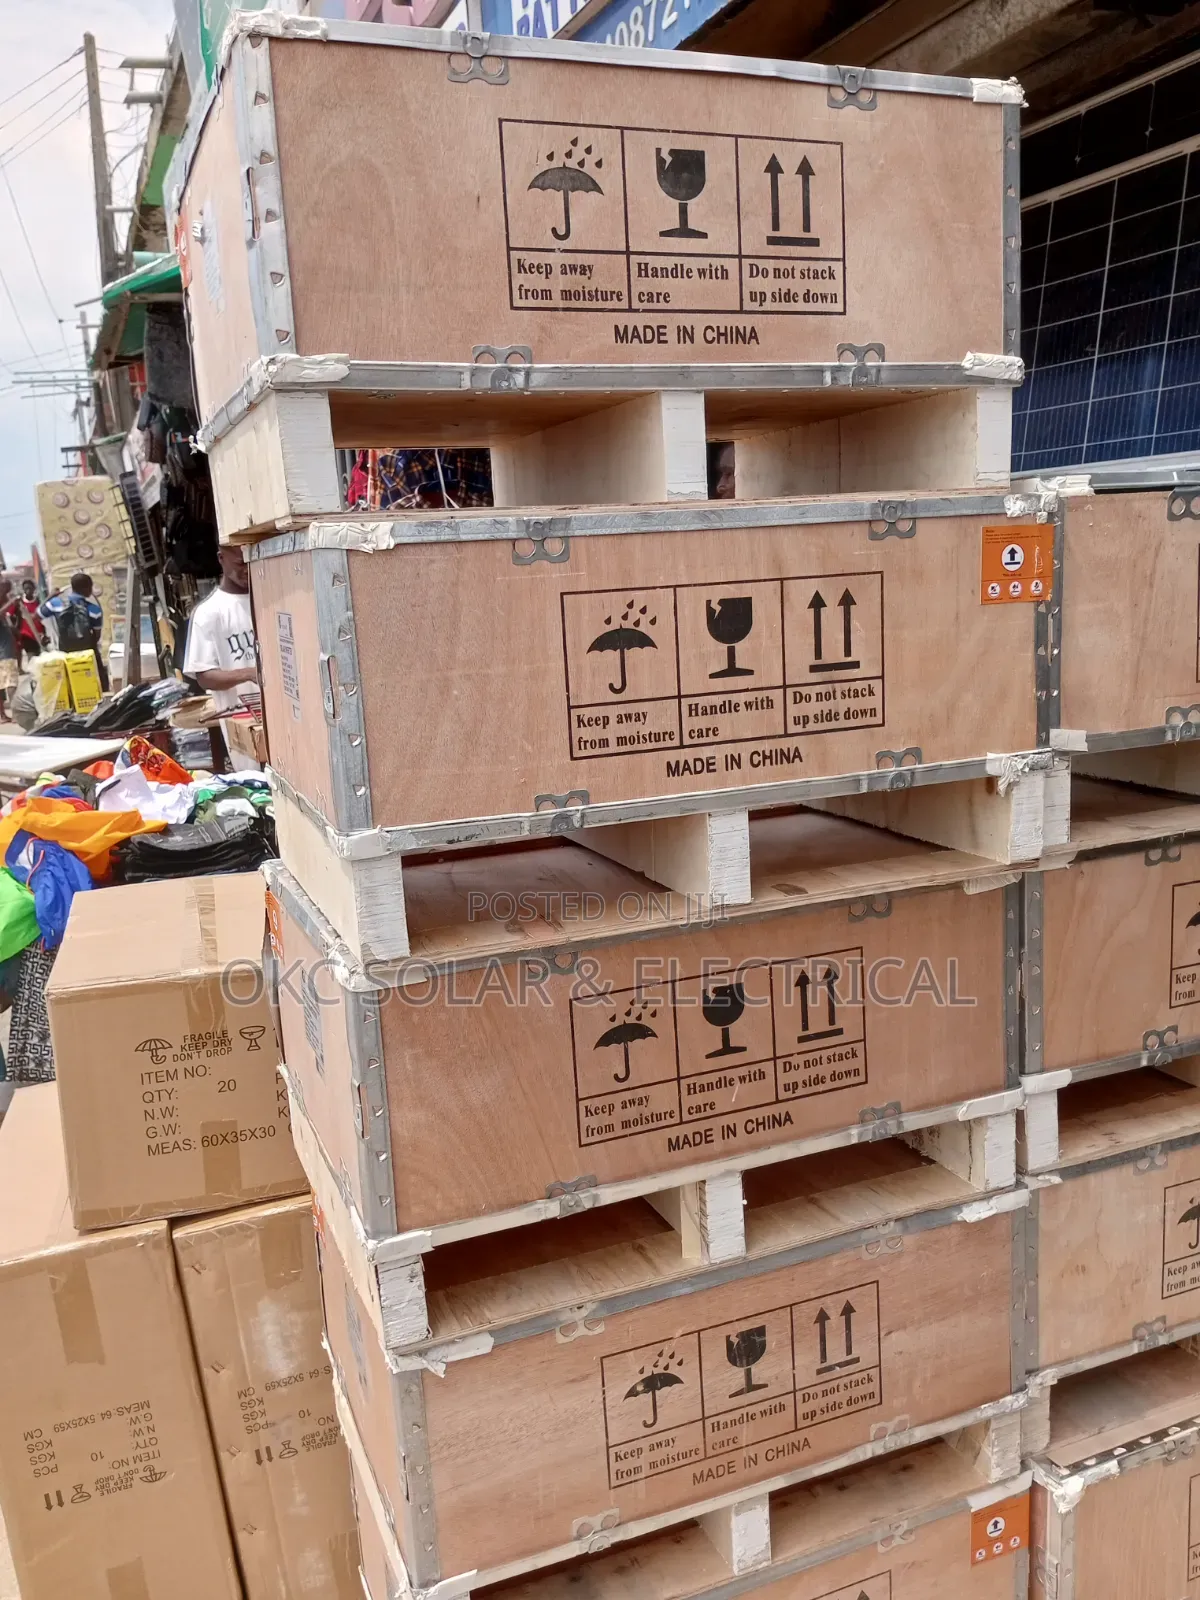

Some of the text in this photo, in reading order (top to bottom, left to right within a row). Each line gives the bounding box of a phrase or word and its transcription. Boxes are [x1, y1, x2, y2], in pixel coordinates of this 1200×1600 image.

[517, 258, 594, 279] Keep away
[637, 262, 729, 280] Handle with
[749, 263, 836, 280] Do not stack
[518, 286, 623, 302] from moisture
[638, 290, 671, 303] care
[750, 288, 838, 306] up side down
[614, 325, 760, 345] MADE IN CHINA
[792, 684, 876, 705] Do not stack
[688, 697, 774, 718] Handle with
[793, 706, 877, 727] up side down
[576, 710, 648, 729] Keep away
[577, 729, 675, 751] from moisture
[688, 726, 720, 740] care
[666, 746, 803, 778] MADE IN CHINA
[1175, 972, 1197, 985] Keep
[1174, 988, 1196, 1001] from
[181, 1038, 233, 1052] KEEP DRY
[183, 1030, 229, 1043] FRAGILE
[172, 1047, 232, 1062] DON'T DROP
[782, 1047, 859, 1074] Do not stack
[141, 1064, 212, 1085] ITEM NO:
[687, 1069, 766, 1096] Handle with
[783, 1066, 860, 1094] up side down
[142, 1088, 178, 1104] QTY:
[218, 1079, 237, 1093] 20
[144, 1106, 179, 1122] N.W:
[584, 1095, 650, 1119] Keep away
[687, 1100, 716, 1116] care
[146, 1123, 181, 1139] G.W:
[585, 1108, 675, 1138] from moisture
[667, 1111, 794, 1152] MADE IN CHINA
[147, 1138, 197, 1157] MEAS:
[201, 1125, 276, 1148] 60X35X30
[1167, 1264, 1188, 1277] Keep
[1166, 1280, 1186, 1292] from
[237, 1386, 255, 1400] CM
[801, 1374, 874, 1404] Do not stack
[114, 1400, 151, 1416] MEAS:
[240, 1397, 264, 1411] KGS
[802, 1391, 876, 1423] up side down
[242, 1408, 267, 1423] KGS
[245, 1408, 312, 1435] 10 PCS
[711, 1402, 786, 1432] Handle with
[23, 1428, 43, 1441] CM
[26, 1412, 153, 1453] G.W: KGS
[301, 1431, 320, 1441] DROP
[301, 1432, 339, 1448] KEEP DRY
[29, 1424, 156, 1466] N.W: KGS
[305, 1439, 337, 1452] FRAGILE
[614, 1435, 677, 1463] Keep away
[711, 1435, 738, 1451] care
[33, 1436, 158, 1478] QTY: 10 PCS
[109, 1449, 161, 1470] ITEM NO:
[615, 1446, 700, 1481] from moisture
[692, 1437, 811, 1486] MADE IN CHINA
[95, 1468, 139, 1486] DON'T DROP
[95, 1476, 134, 1492] KEEP DRY
[99, 1483, 133, 1496] FRAGILE
